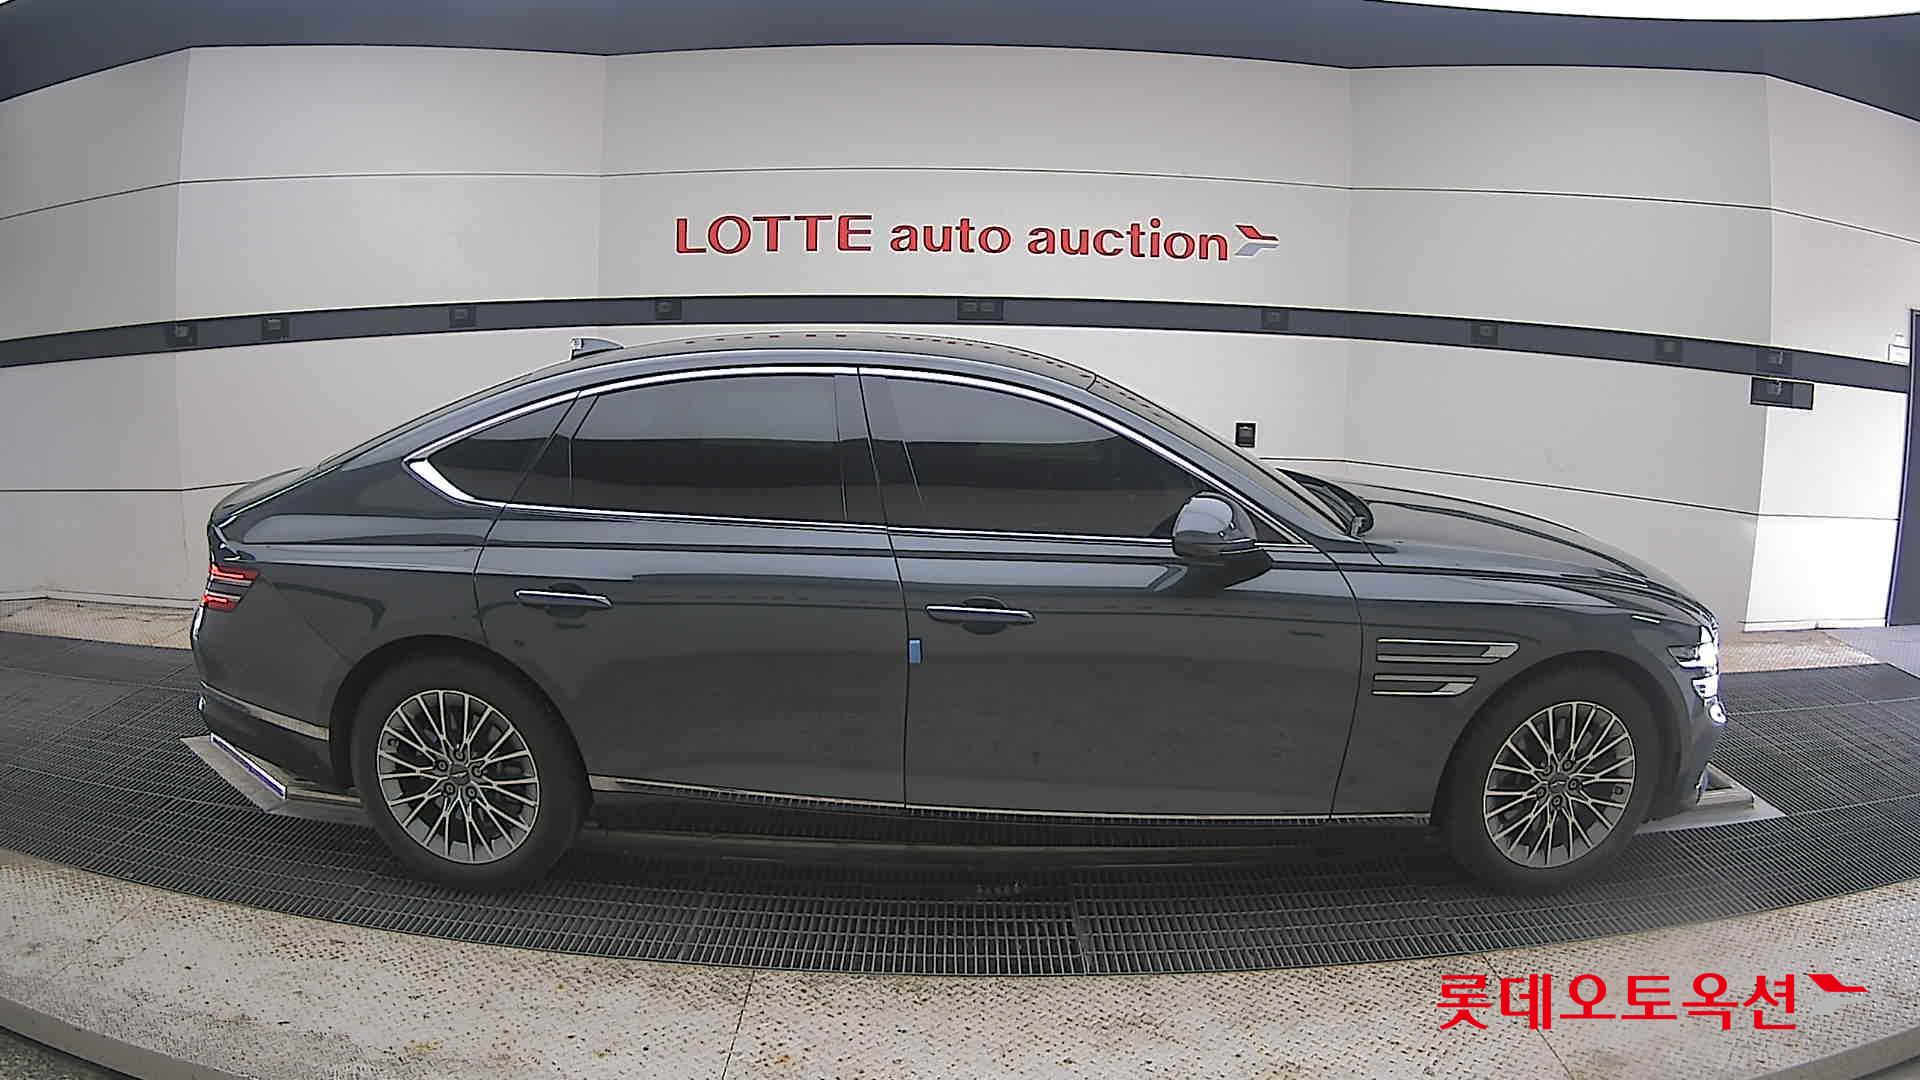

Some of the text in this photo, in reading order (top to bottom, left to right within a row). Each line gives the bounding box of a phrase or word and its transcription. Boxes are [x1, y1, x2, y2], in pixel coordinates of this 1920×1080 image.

[675, 215, 1229, 261] LOTTE auto auction
